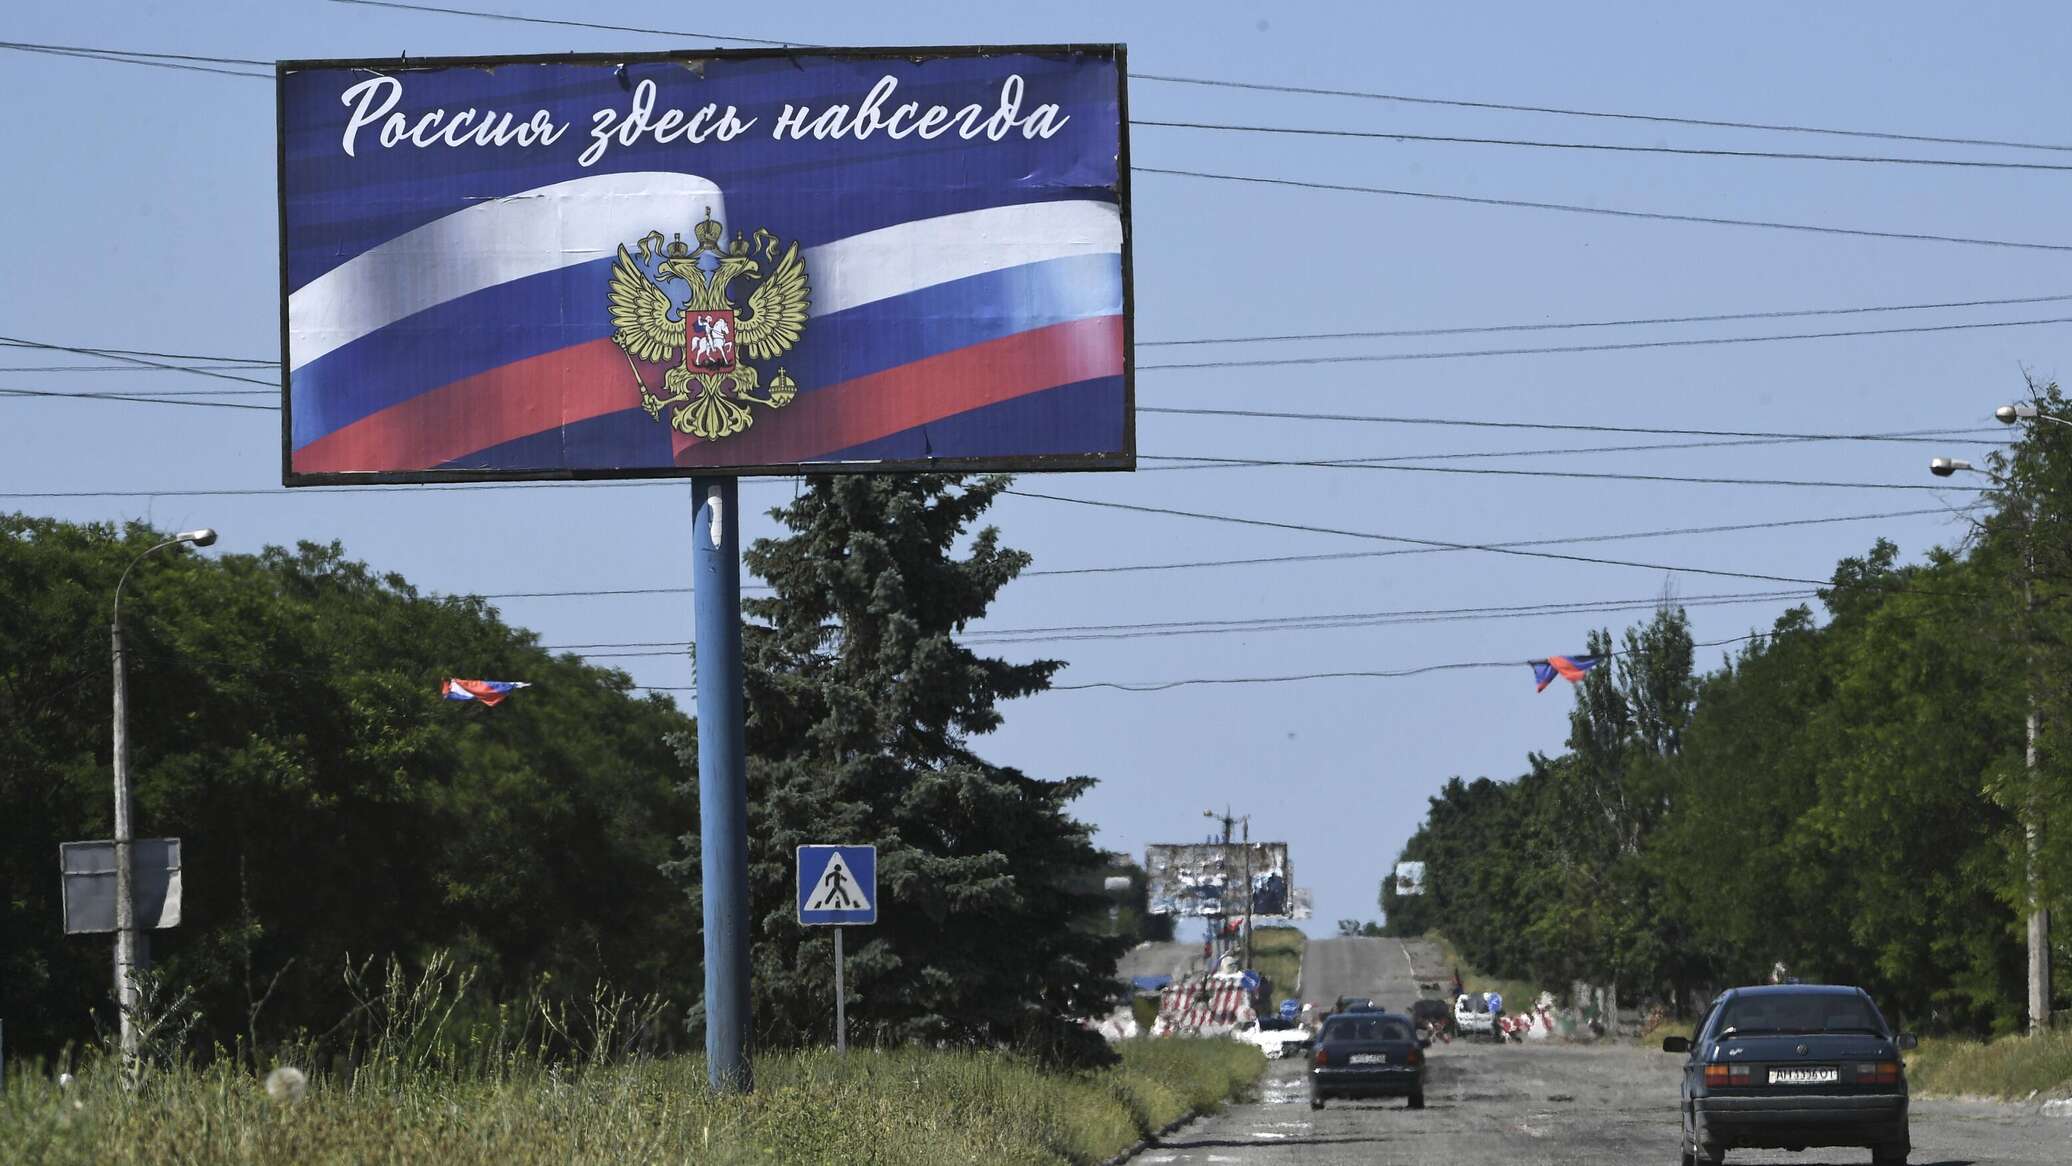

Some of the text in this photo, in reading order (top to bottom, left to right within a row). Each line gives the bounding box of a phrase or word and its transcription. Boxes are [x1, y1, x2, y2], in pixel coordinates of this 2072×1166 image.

[340, 73, 1071, 168] Россия здесь навсегда
